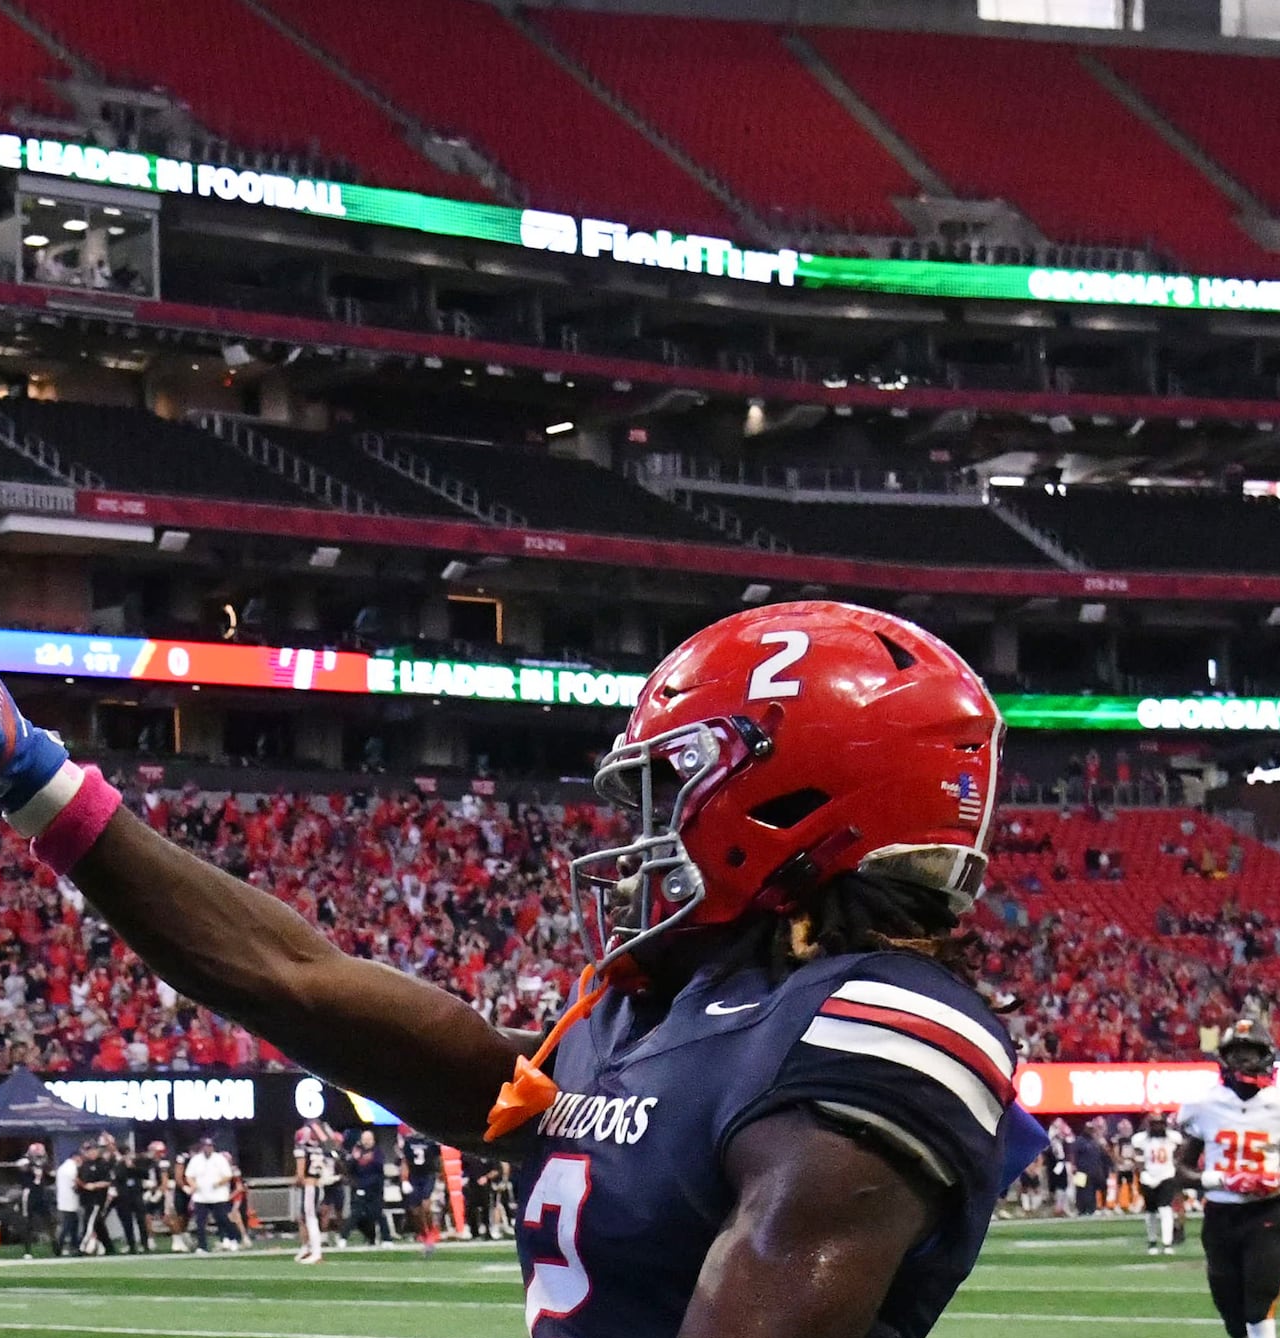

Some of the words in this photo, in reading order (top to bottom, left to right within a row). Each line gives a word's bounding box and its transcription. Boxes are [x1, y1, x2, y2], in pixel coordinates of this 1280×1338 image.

[27, 138, 151, 188] LEADER
[157, 158, 193, 194] IN
[197, 165, 346, 216] FOOTBALL
[581, 218, 799, 286] FieldTurf
[1028, 269, 1195, 306] GEORGIA'S
[166, 646, 190, 677] 0
[400, 660, 517, 699] LEADER
[519, 668, 554, 702] IN
[748, 630, 811, 701] 2
[295, 1077, 325, 1119] 6
[1018, 1070, 1043, 1107] 0
[1214, 1130, 1272, 1174] 35
